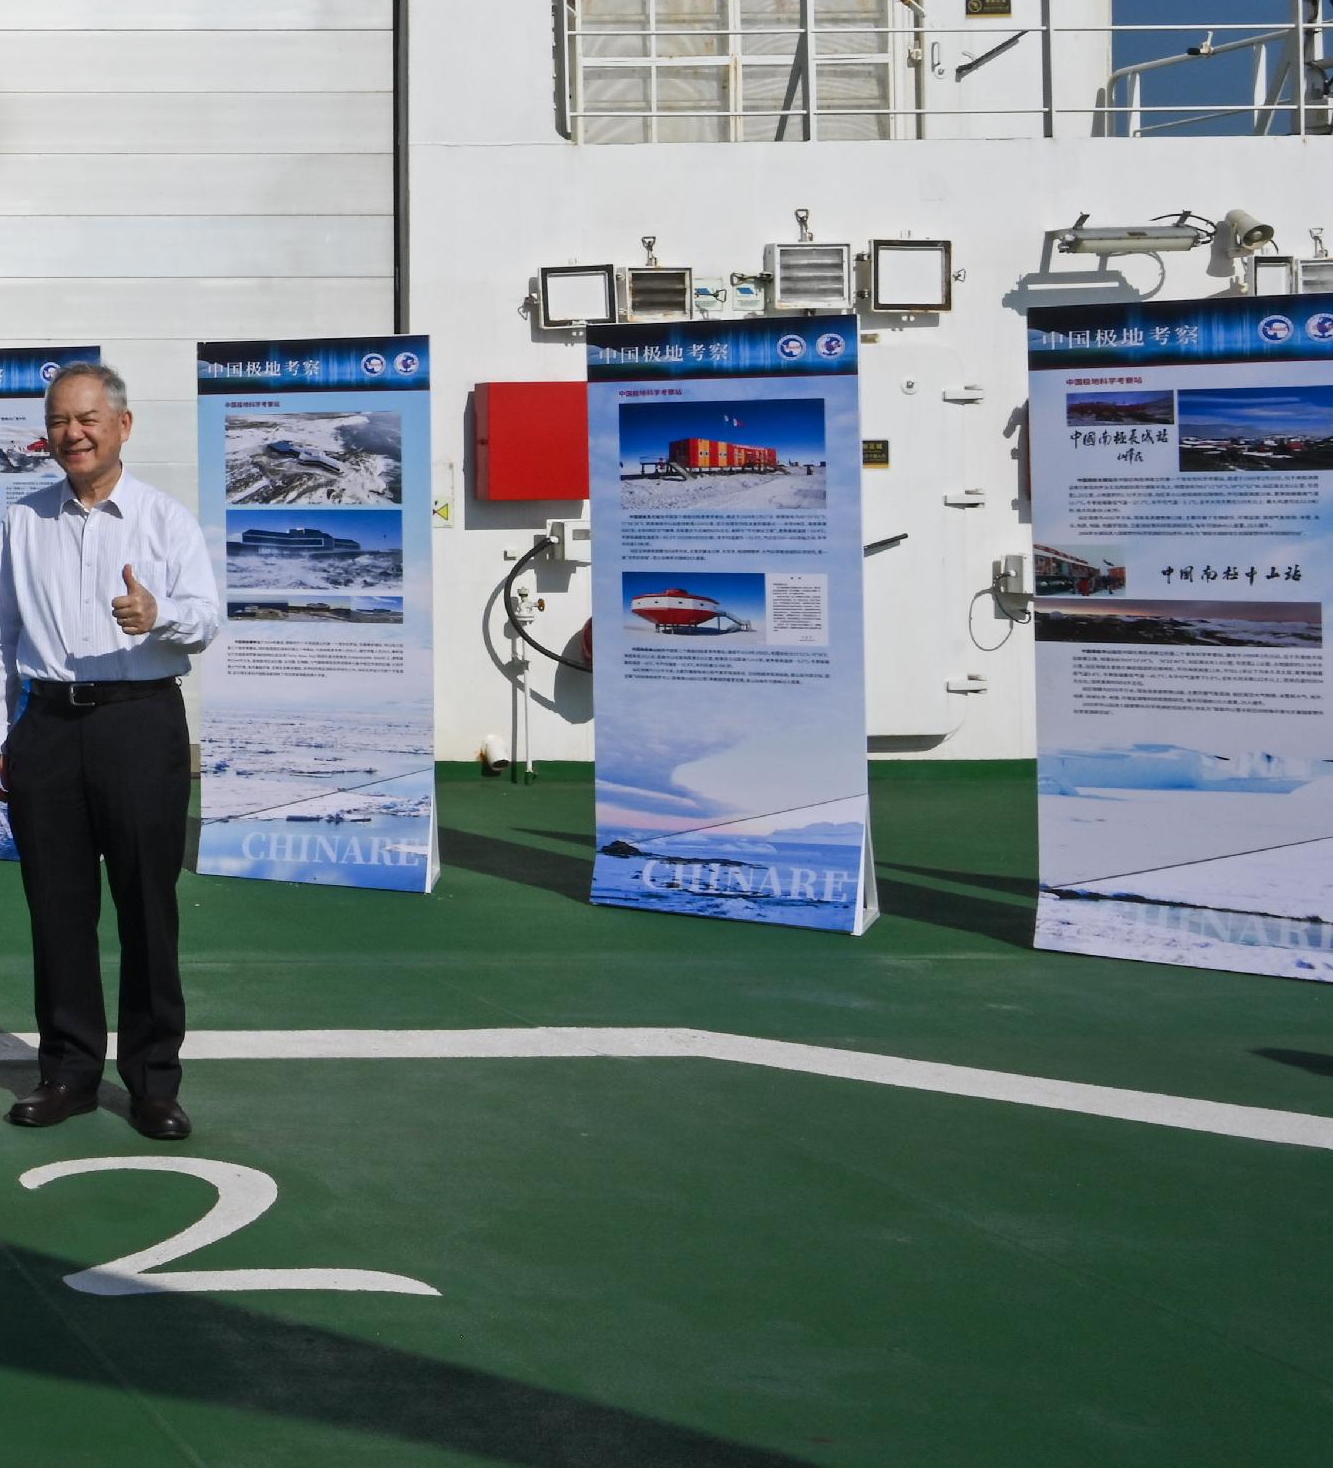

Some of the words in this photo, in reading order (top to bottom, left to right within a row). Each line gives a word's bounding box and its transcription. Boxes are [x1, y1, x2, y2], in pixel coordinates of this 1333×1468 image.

[1042, 325, 1198, 350] 中国极地考察
[599, 343, 728, 365] 中国极地考察
[207, 359, 320, 378] 中国极地考察
[242, 832, 420, 867] CHINARE
[642, 860, 848, 903] CHINARE
